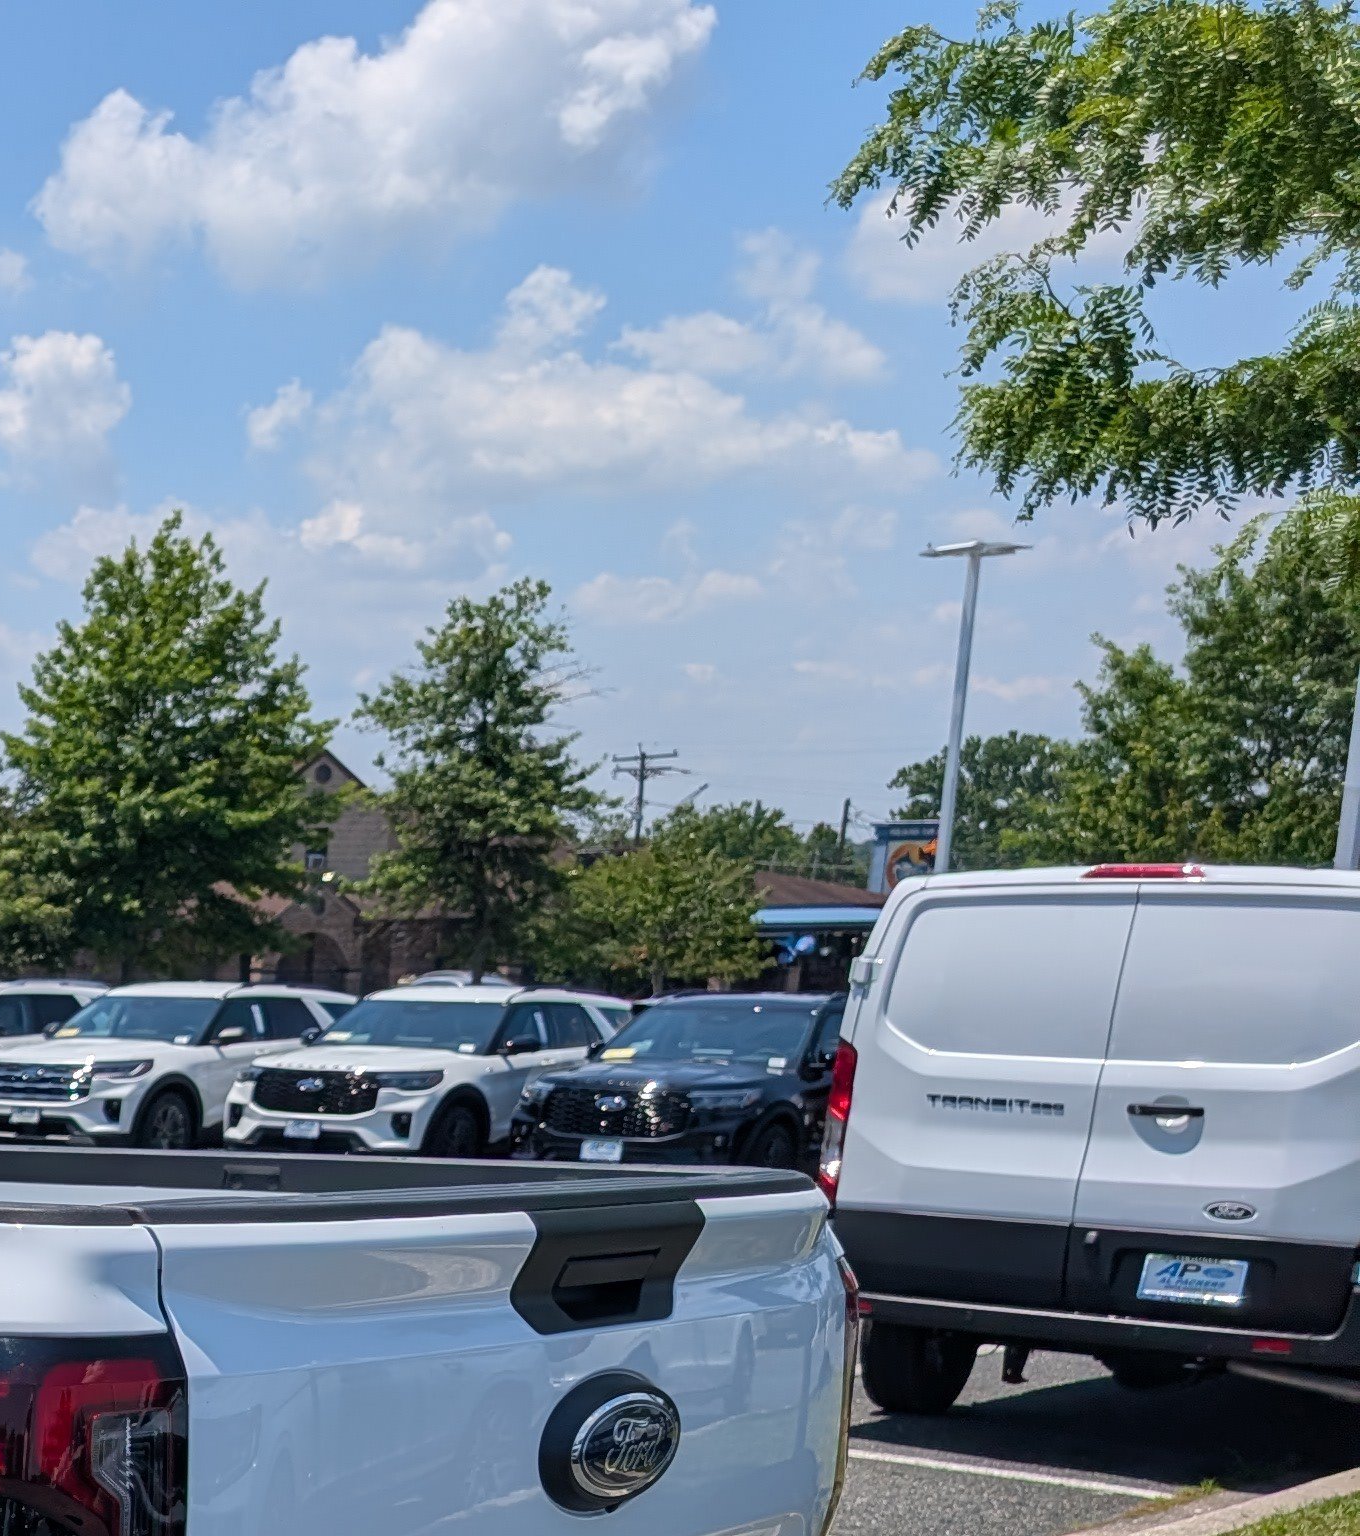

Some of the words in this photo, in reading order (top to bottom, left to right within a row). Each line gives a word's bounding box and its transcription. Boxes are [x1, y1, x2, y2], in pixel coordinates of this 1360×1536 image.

[926, 1093, 1030, 1114] TRANSIT
[1156, 1262, 1202, 1279] AP
[604, 1415, 664, 1475] Ford
